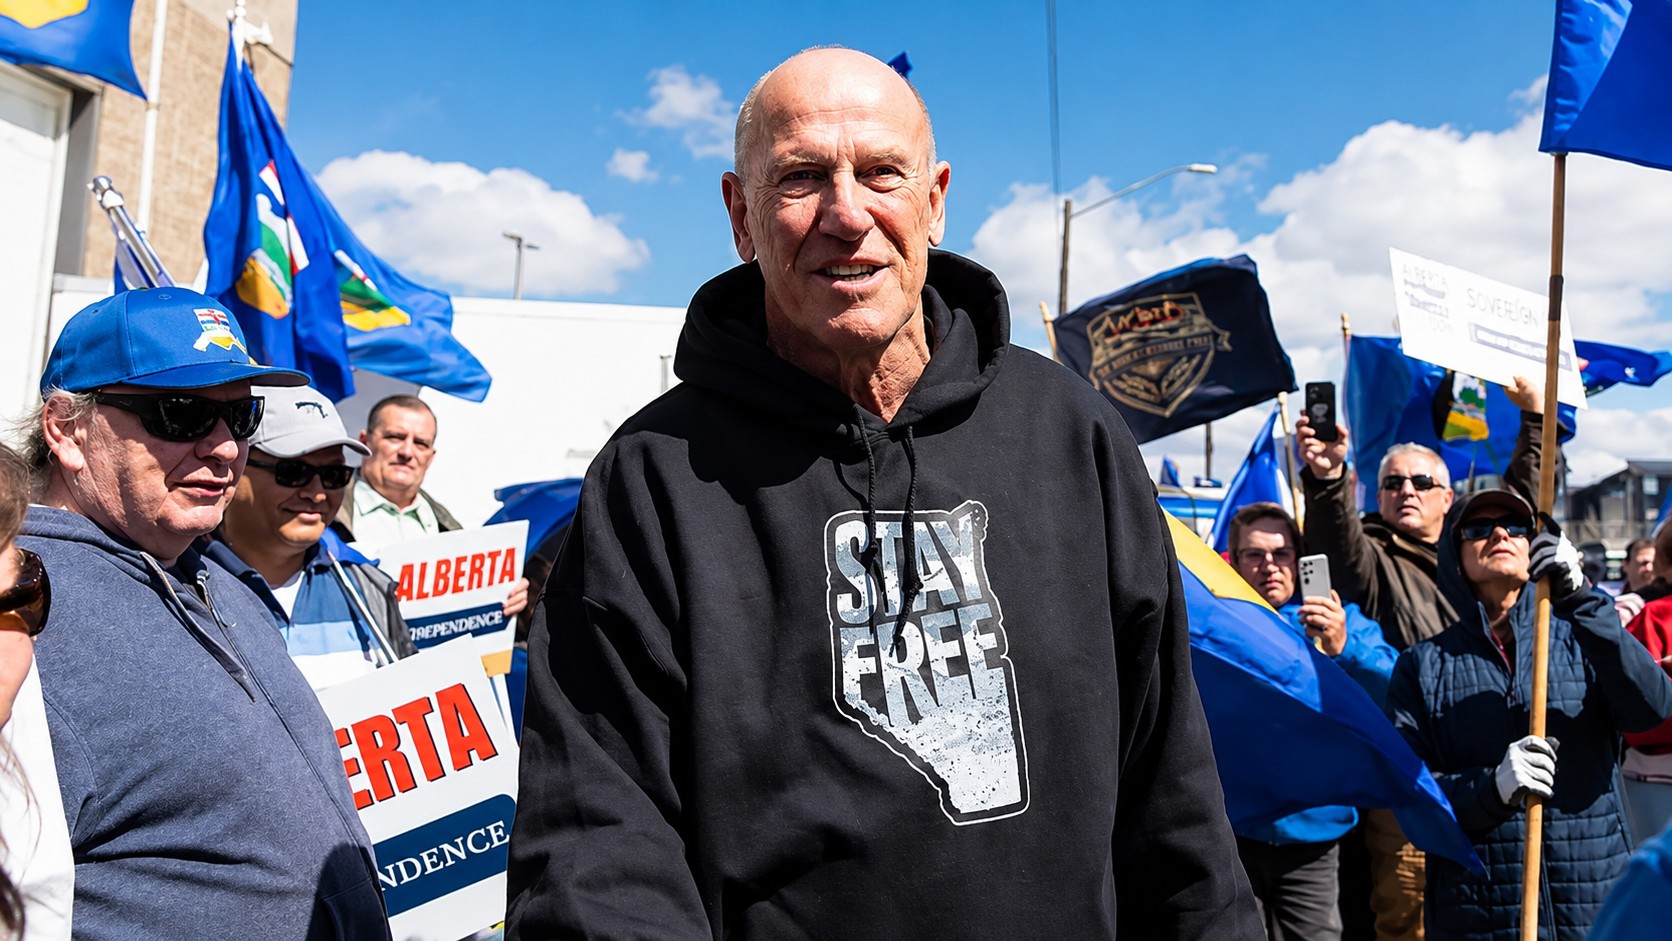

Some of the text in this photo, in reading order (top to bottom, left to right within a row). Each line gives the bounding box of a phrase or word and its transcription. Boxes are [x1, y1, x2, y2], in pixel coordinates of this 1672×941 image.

[1467, 288, 1545, 328] SOVEREIGN
[396, 547, 516, 602] ALBERTA
[835, 512, 983, 625] STAY
[839, 602, 1008, 728] FREE
[335, 682, 499, 811] ERTA
[378, 820, 511, 892] NDENCE
